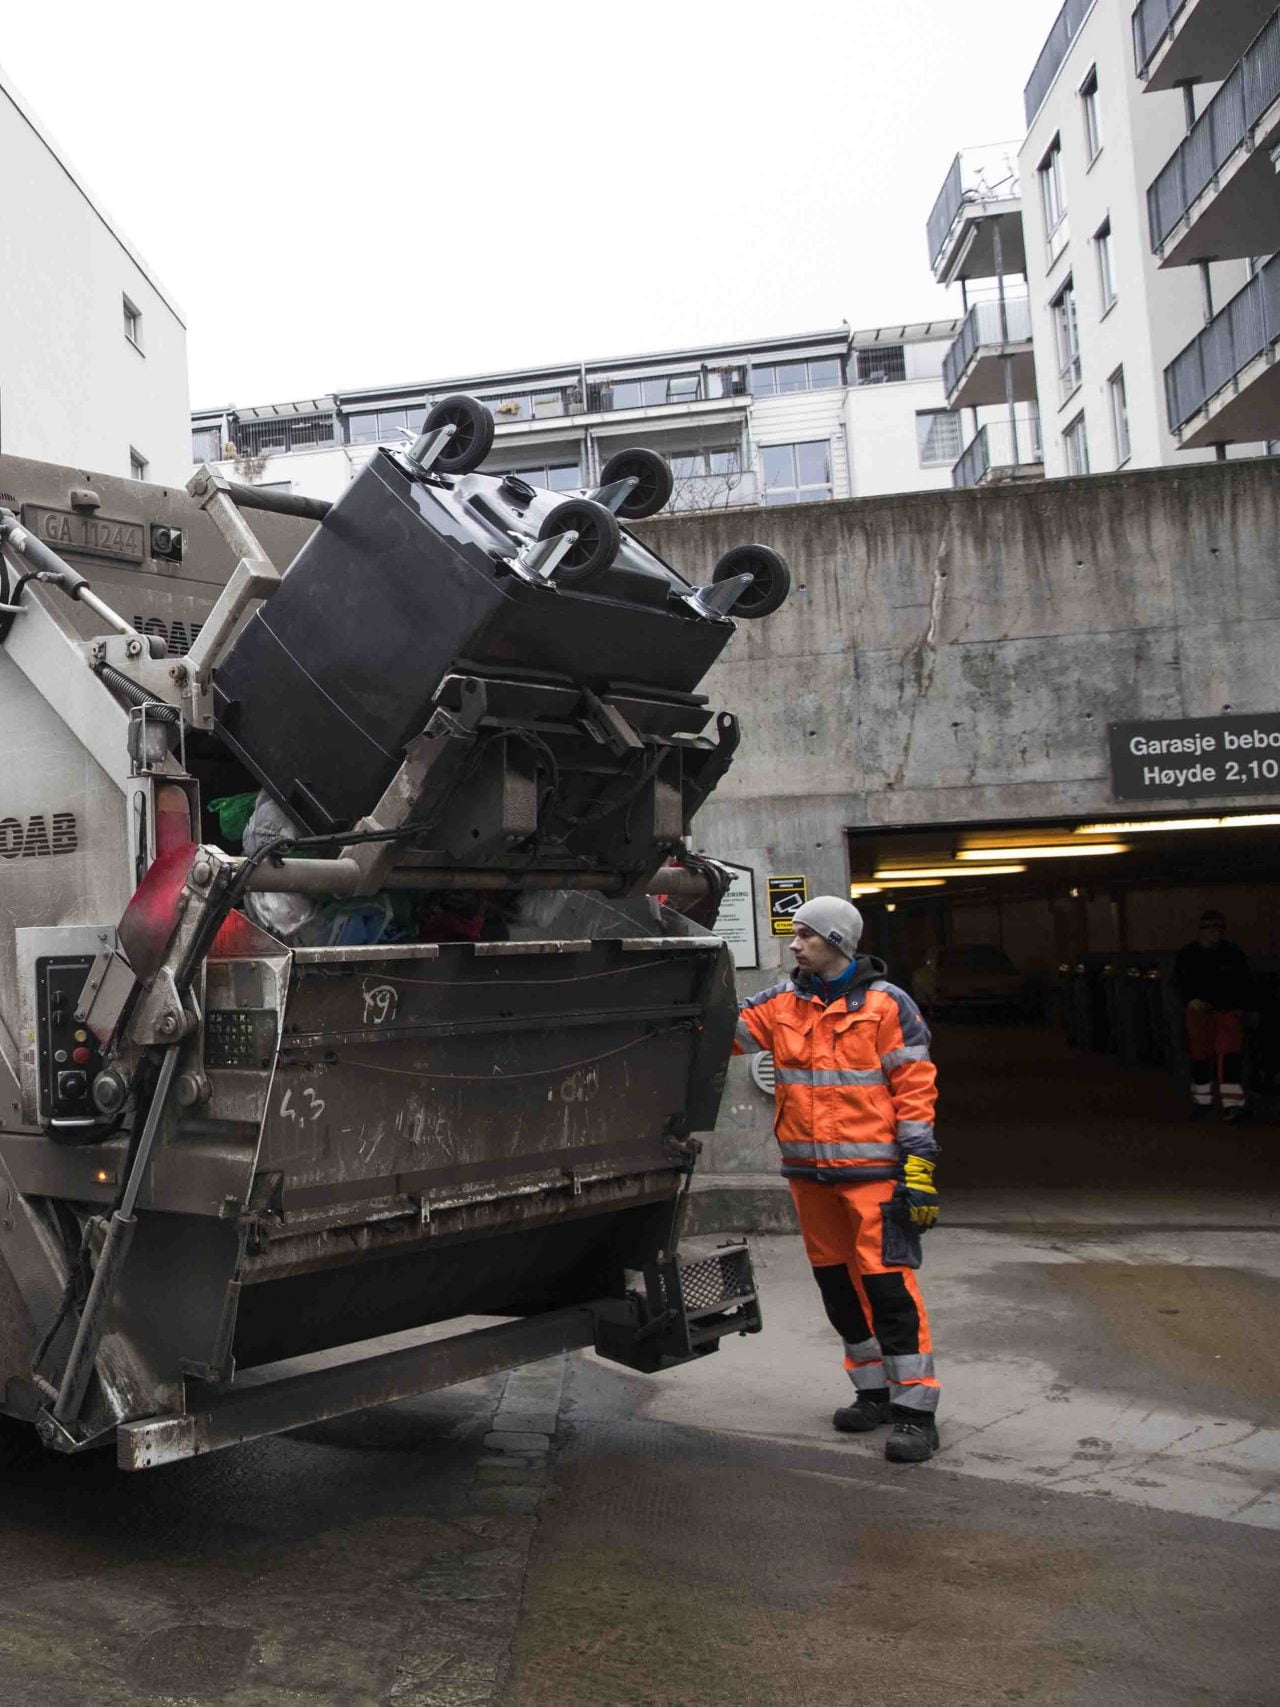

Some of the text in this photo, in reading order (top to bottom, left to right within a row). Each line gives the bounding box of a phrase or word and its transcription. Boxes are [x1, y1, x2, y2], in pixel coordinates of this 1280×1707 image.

[44, 514, 138, 551] GA 11244
[1129, 733, 1217, 756] Garasje
[1143, 759, 1279, 787] Høyde 2,10
